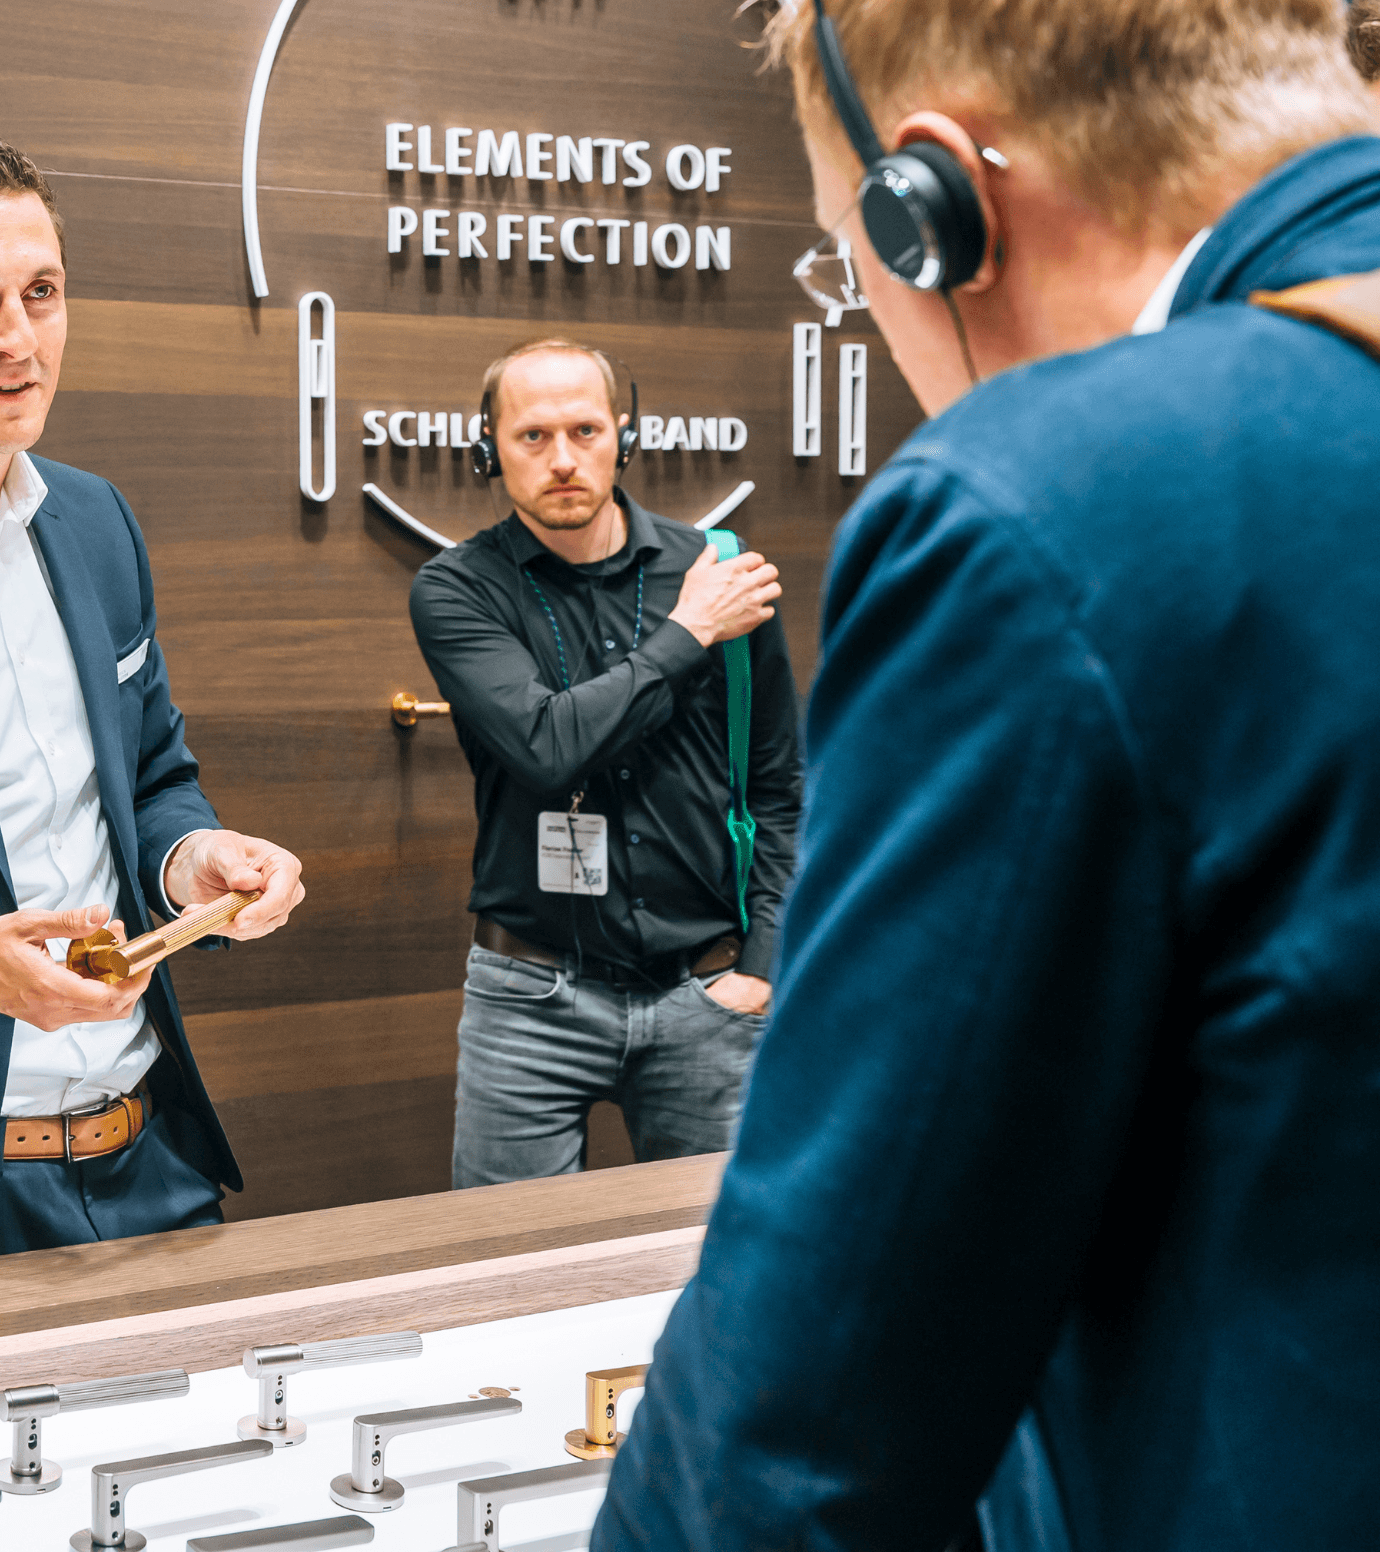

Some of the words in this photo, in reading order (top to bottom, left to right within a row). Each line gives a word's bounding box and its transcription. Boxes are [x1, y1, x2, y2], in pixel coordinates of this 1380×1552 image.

[385, 122, 652, 187] ELEMENTS
[666, 144, 732, 192] OF
[387, 206, 731, 271] PERFECTION
[640, 415, 748, 452] BAND
